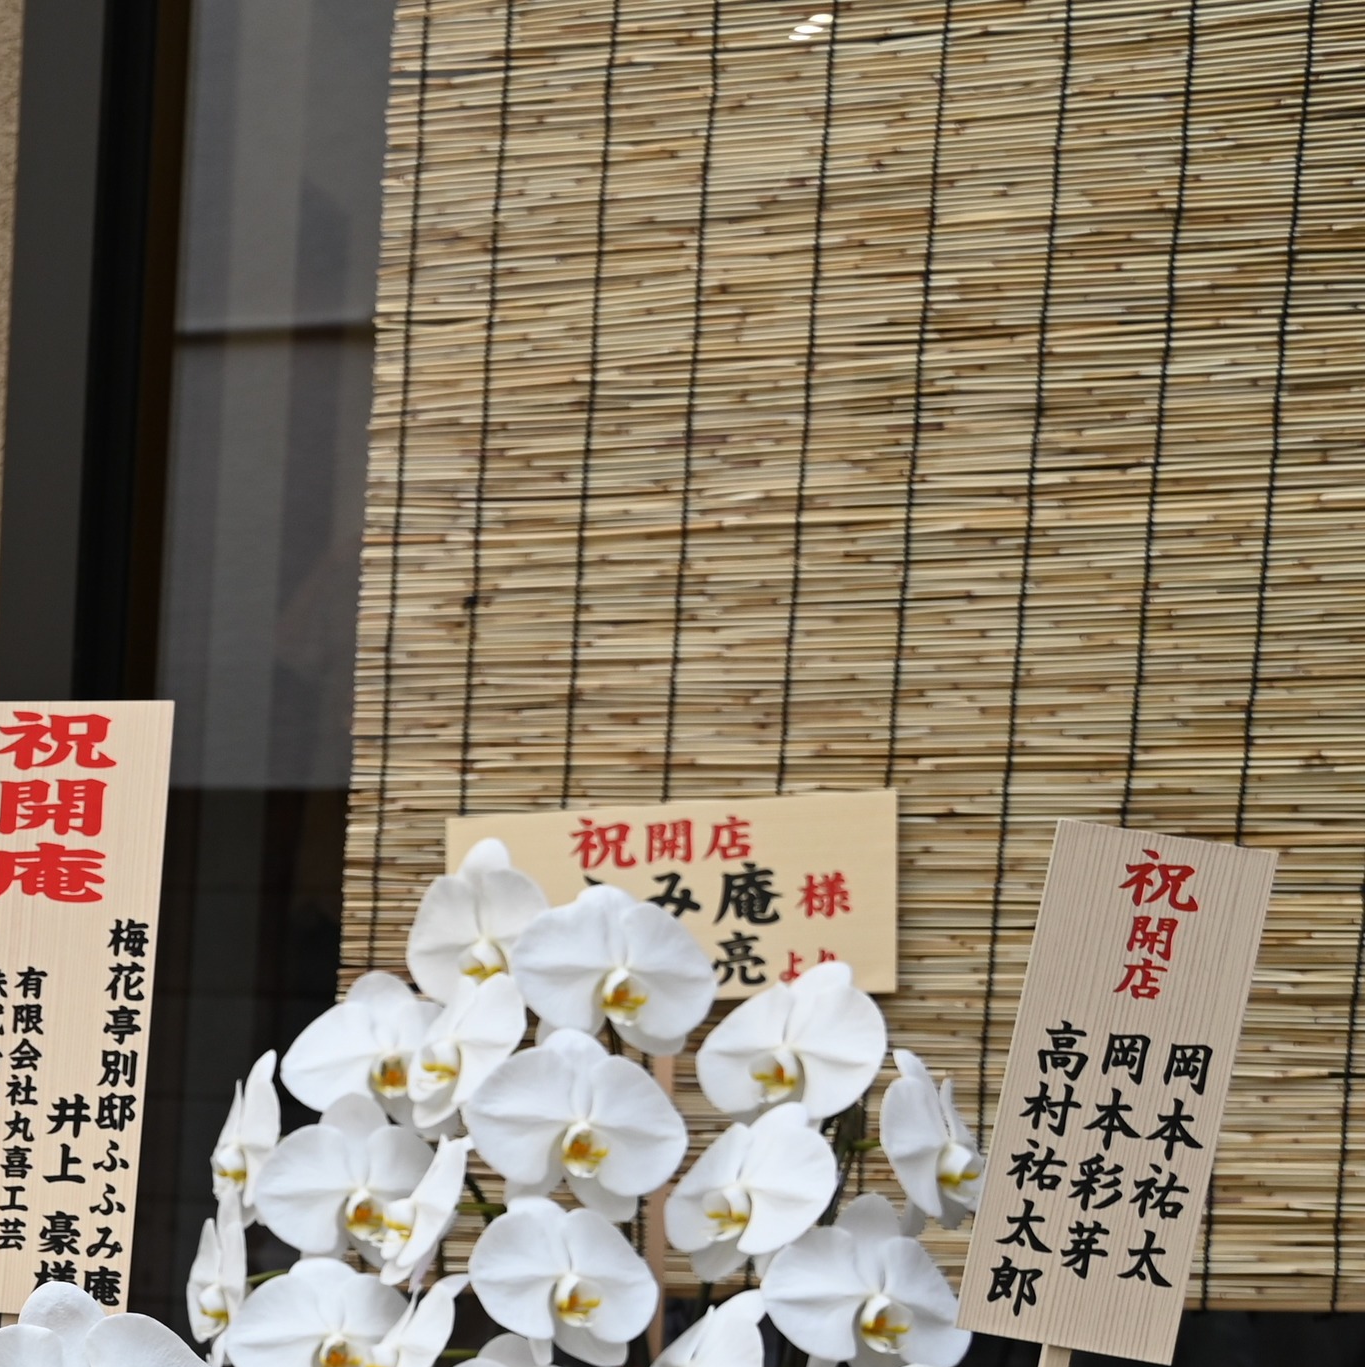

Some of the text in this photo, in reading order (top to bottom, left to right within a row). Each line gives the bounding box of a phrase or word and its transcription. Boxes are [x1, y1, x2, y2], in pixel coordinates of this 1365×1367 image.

[569, 815, 753, 870] 祝開店
[1113, 847, 1199, 1001] 祝開店
[43, 1093, 92, 1186] 井上
[83, 918, 150, 1308] 梅花亭別邸ふふみ庵
[986, 1019, 1090, 1317] 高村祐太郎
[1059, 1032, 1151, 1280] 岡本彩芽
[1117, 1042, 1215, 1289] 岡本祐太
